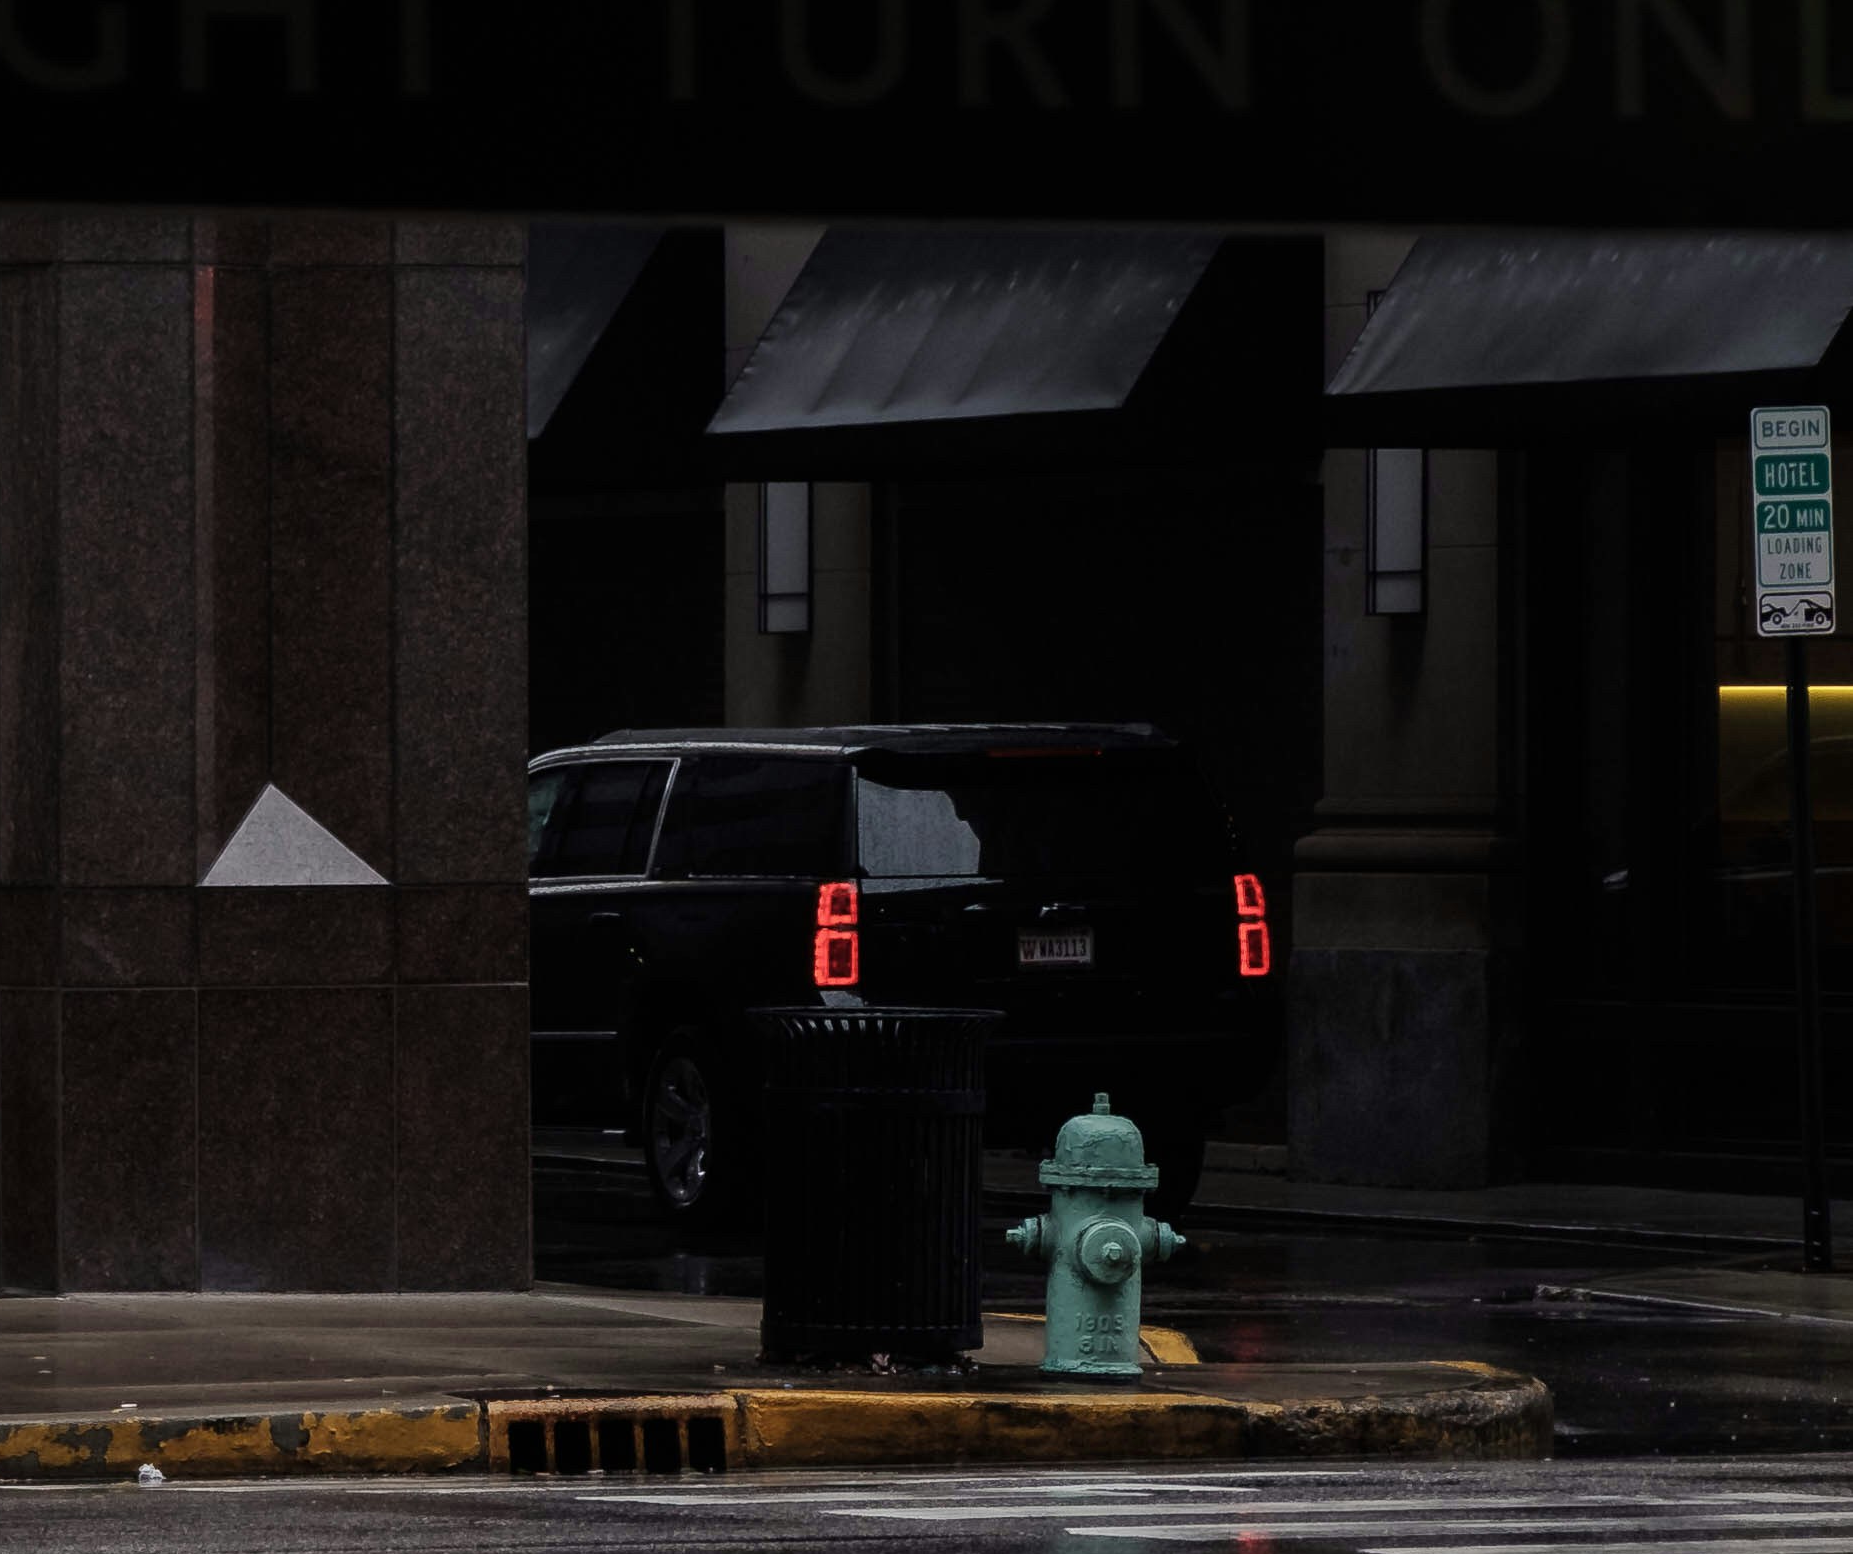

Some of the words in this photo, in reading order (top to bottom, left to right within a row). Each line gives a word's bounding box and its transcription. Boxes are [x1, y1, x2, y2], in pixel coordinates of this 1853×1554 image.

[1762, 419, 1820, 438] BEGIN
[1764, 462, 1820, 488] HOTEL
[1764, 504, 1790, 529] 20
[1796, 508, 1825, 528] MIN
[1767, 537, 1822, 555] LOADING
[1779, 562, 1812, 580] ZONE
